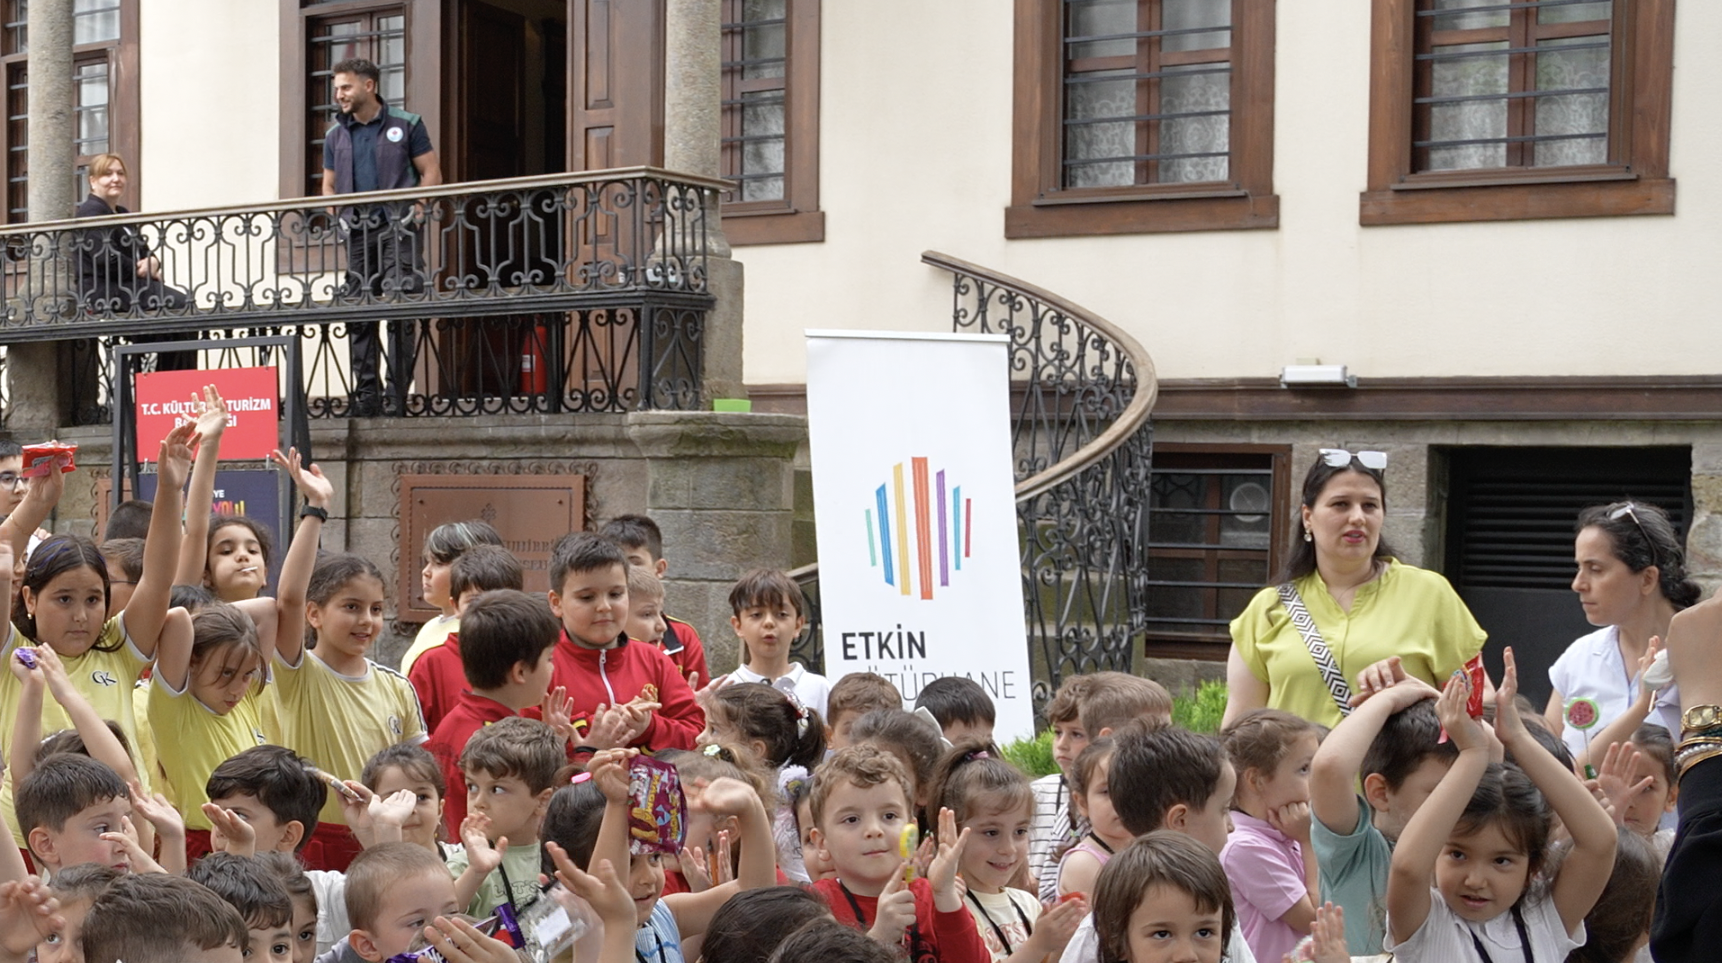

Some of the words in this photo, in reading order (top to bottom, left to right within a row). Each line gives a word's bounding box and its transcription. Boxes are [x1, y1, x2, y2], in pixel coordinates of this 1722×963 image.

[141, 403, 161, 416] T.C.
[226, 397, 271, 412] TURİZM
[841, 623, 927, 661] ETKİN
